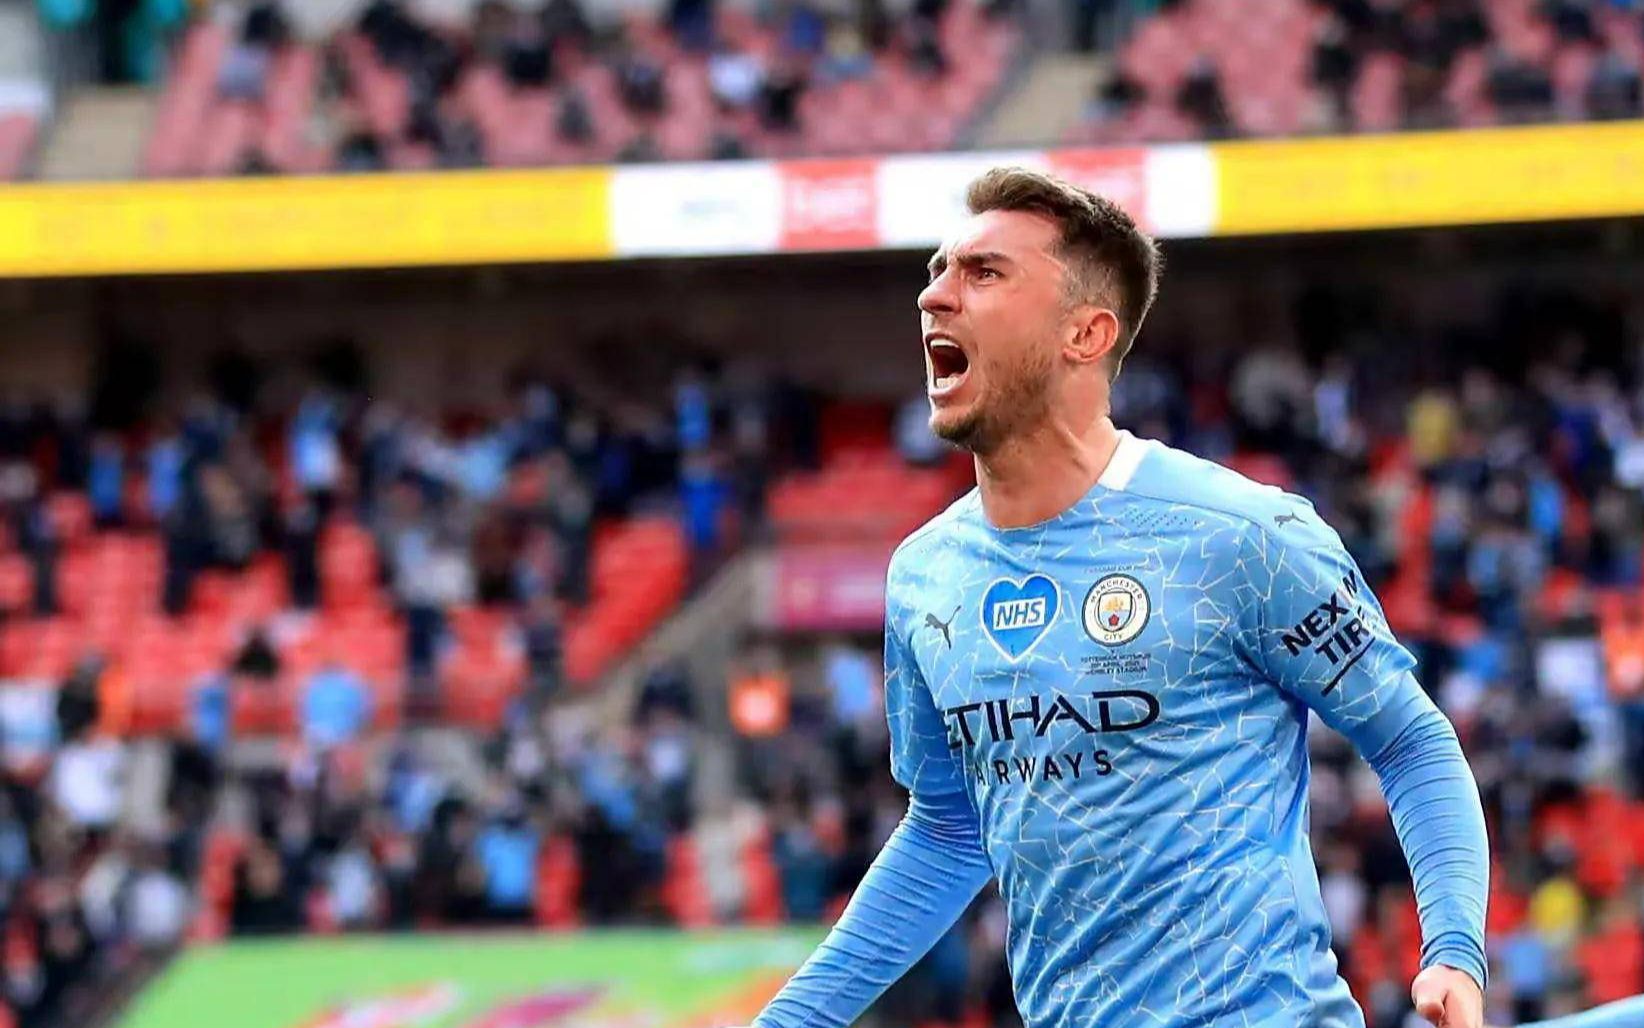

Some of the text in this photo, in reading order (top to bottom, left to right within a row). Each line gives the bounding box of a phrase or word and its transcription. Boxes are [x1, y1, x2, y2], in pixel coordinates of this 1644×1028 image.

[1090, 577, 1144, 604] MANCHESTER
[996, 601, 1043, 628] NHS
[1281, 569, 1358, 657] NEXN
[1103, 630, 1124, 641] CITY
